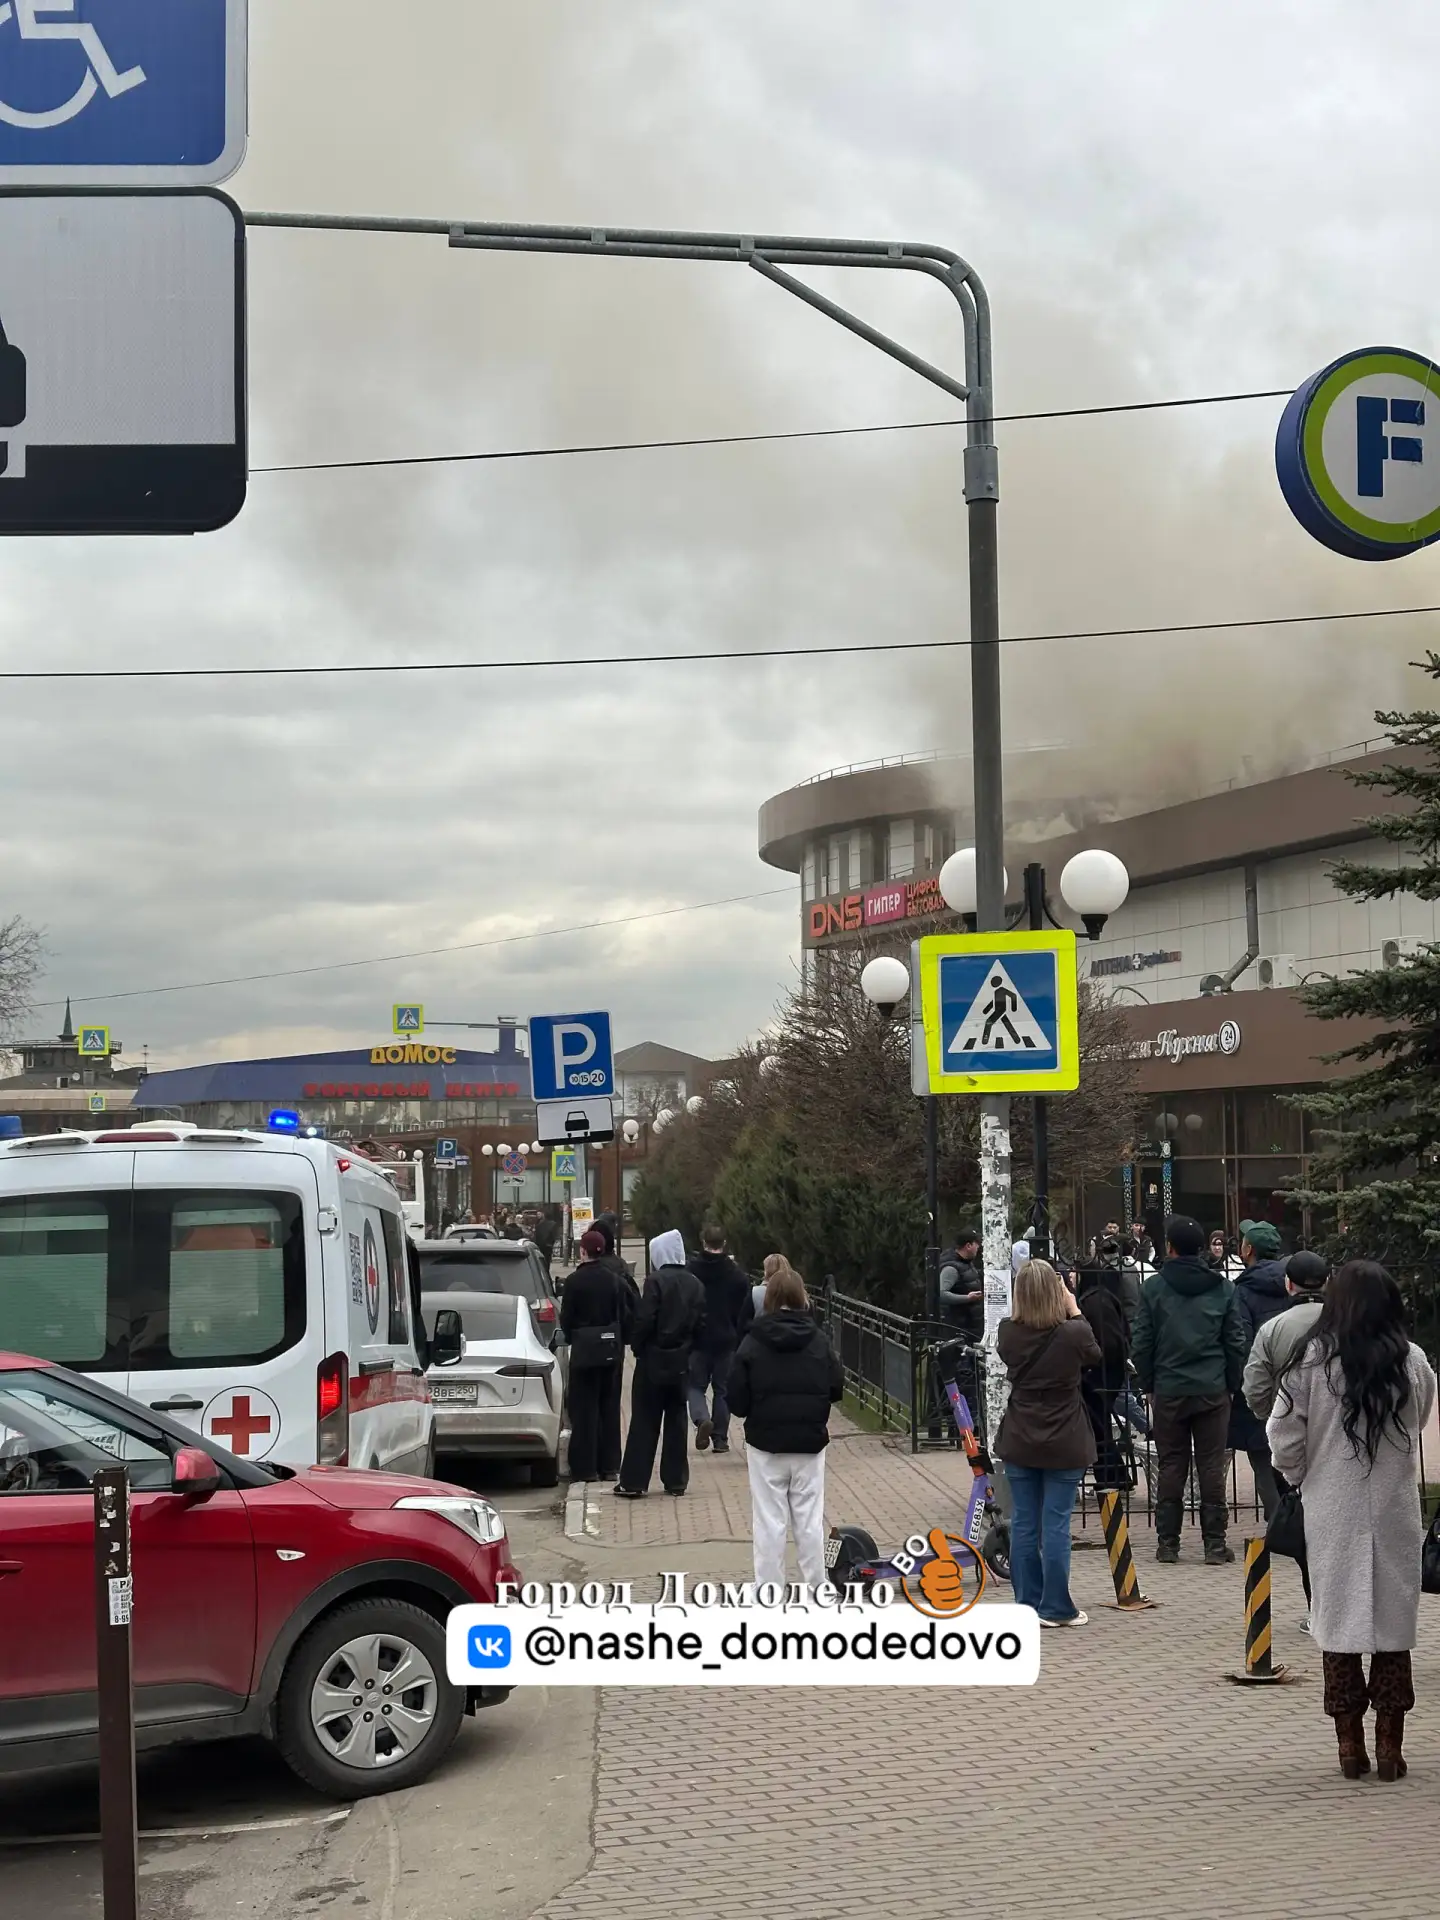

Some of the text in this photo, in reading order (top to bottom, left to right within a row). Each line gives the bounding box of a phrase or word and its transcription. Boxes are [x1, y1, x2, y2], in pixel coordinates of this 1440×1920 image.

[1357, 396, 1425, 497] F
[868, 892, 901, 916] ГИПЕР
[809, 894, 863, 937] DNS
[1154, 1028, 1218, 1064] Кухня
[1224, 1030, 1233, 1041] 24
[370, 1043, 457, 1064] ДОМОС
[552, 1023, 597, 1090] P
[580, 1074, 589, 1083] 15
[591, 1072, 605, 1083] 20
[303, 1081, 520, 1098] ТОРГОВЫЙ ЦЕНТР
[442, 1141, 454, 1156] P
[457, 1385, 474, 1394] 250
[970, 1500, 984, 1540] ЕЕ683Х
